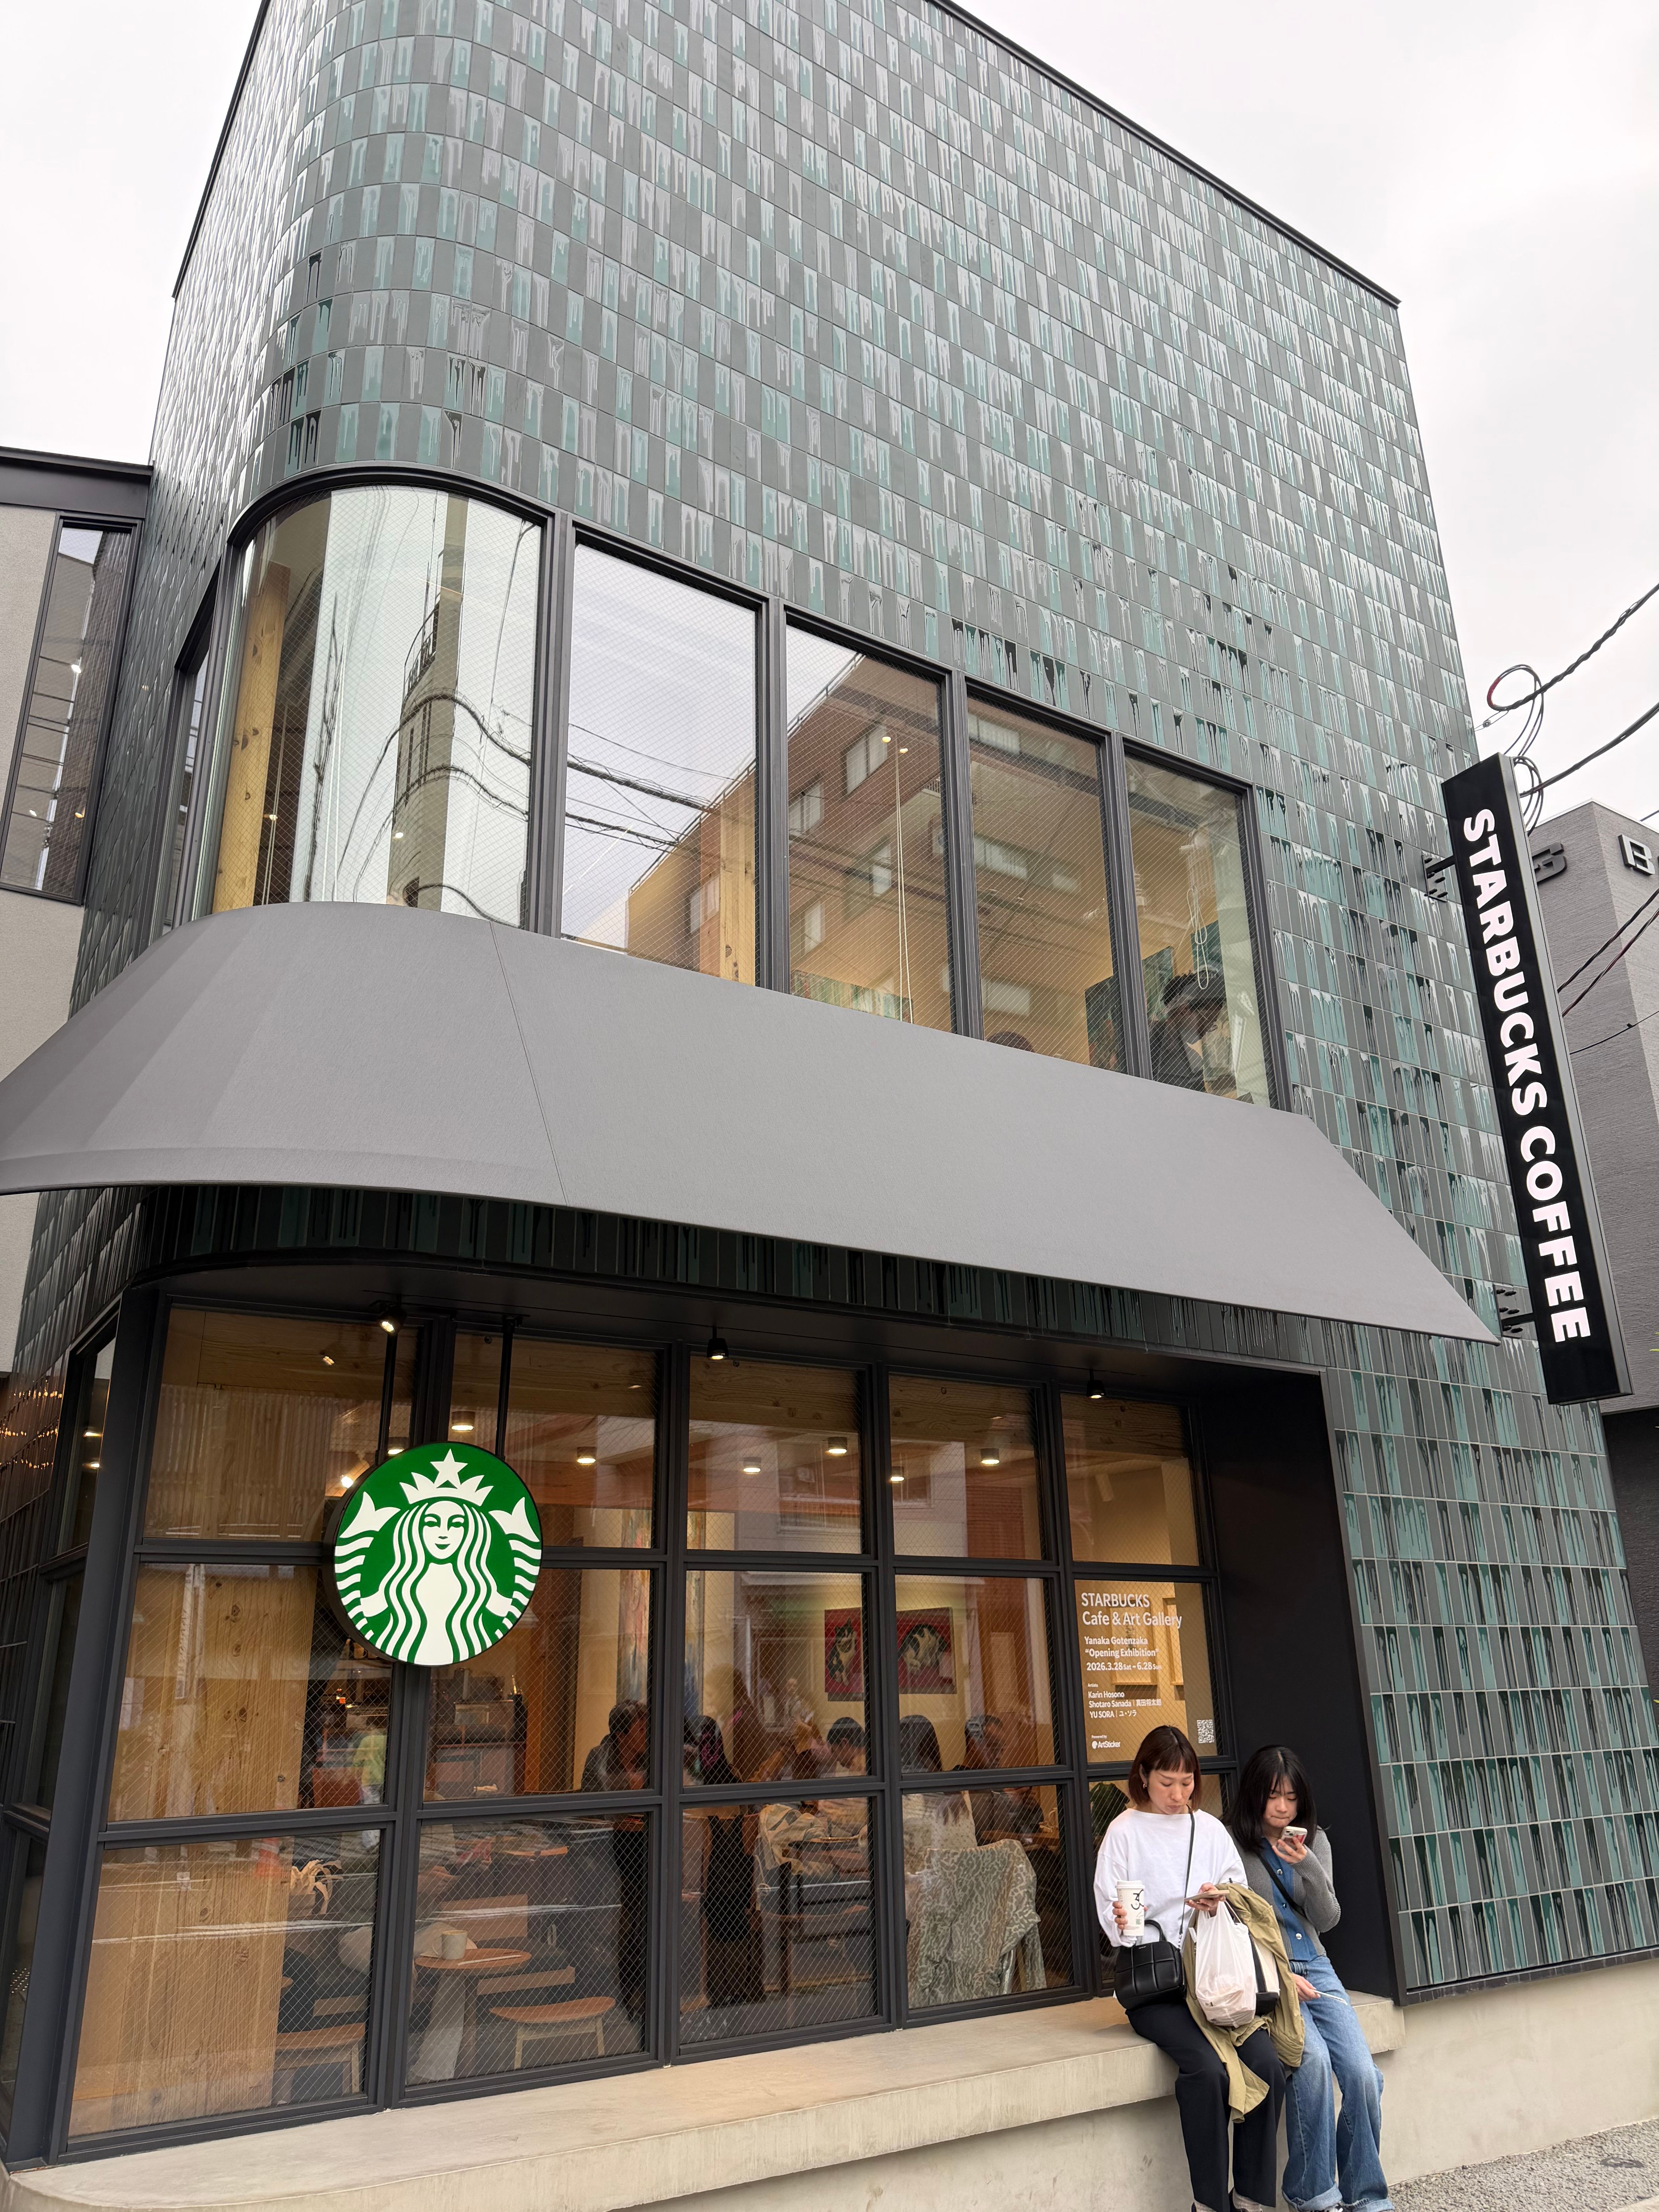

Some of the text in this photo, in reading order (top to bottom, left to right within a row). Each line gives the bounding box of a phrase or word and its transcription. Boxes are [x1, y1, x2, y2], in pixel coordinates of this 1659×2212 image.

[1618, 834, 1659, 876] B
[1463, 808, 1591, 1343] STARBUCKS COFFEE
[1081, 1592, 1150, 1607] STARBUCKS
[1082, 1611, 1182, 1629] Cafe & Art Gallery
[1084, 1636, 1148, 1645] Yanaka Gotenzaka
[1085, 1648, 1120, 1659] “Opening
[1111, 1699, 1132, 1707] Sanada
